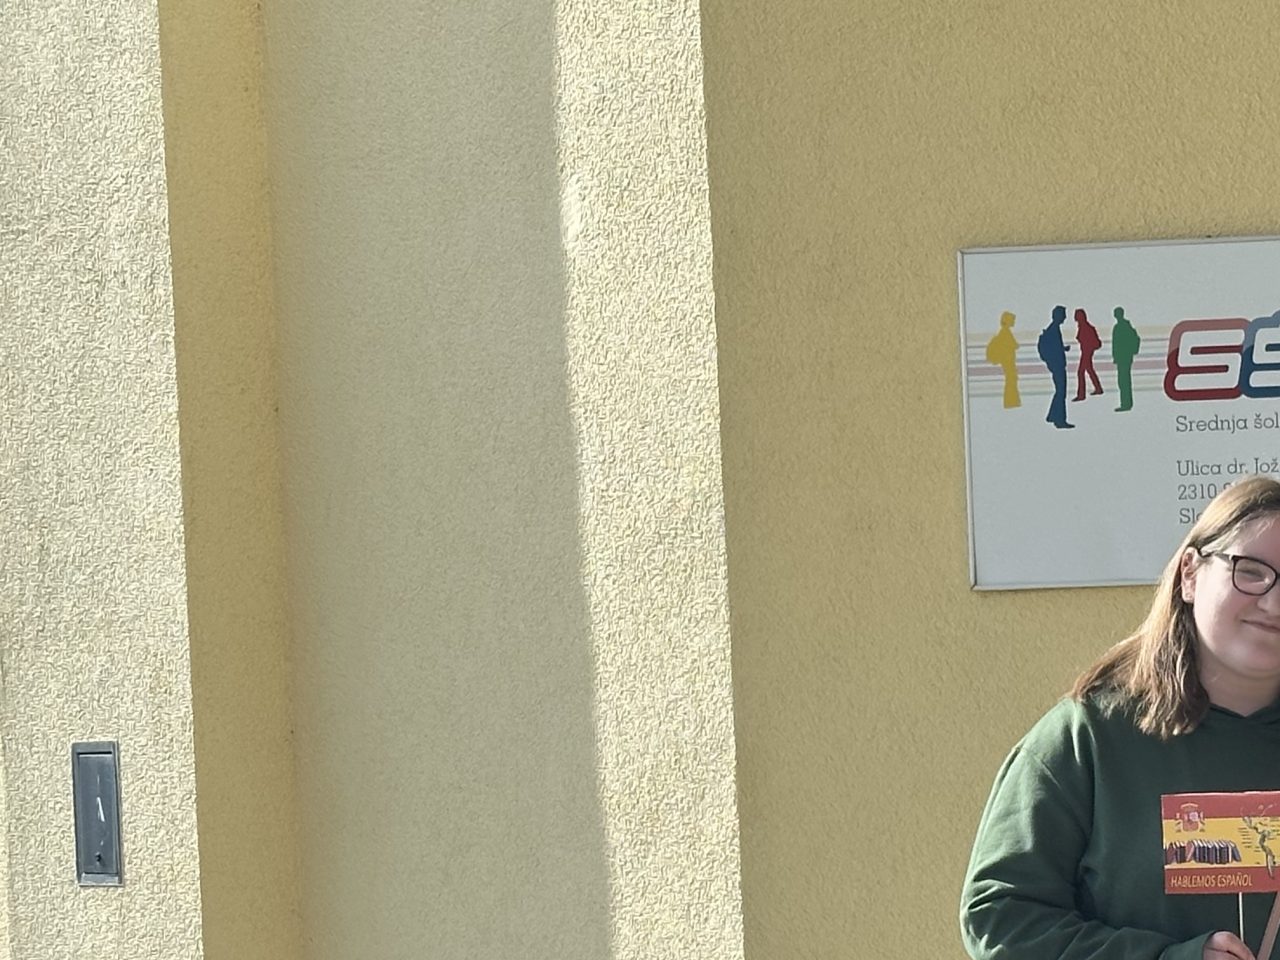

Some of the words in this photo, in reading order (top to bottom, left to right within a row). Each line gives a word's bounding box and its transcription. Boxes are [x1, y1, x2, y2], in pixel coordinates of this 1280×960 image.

[1176, 414, 1248, 434] Srednja
[1177, 459, 1222, 476] Ulica
[1227, 457, 1248, 474] dr.
[1178, 483, 1217, 500] 2310
[1170, 875, 1216, 888] HABLEMOS
[1217, 872, 1253, 887] ESPAÑOL
